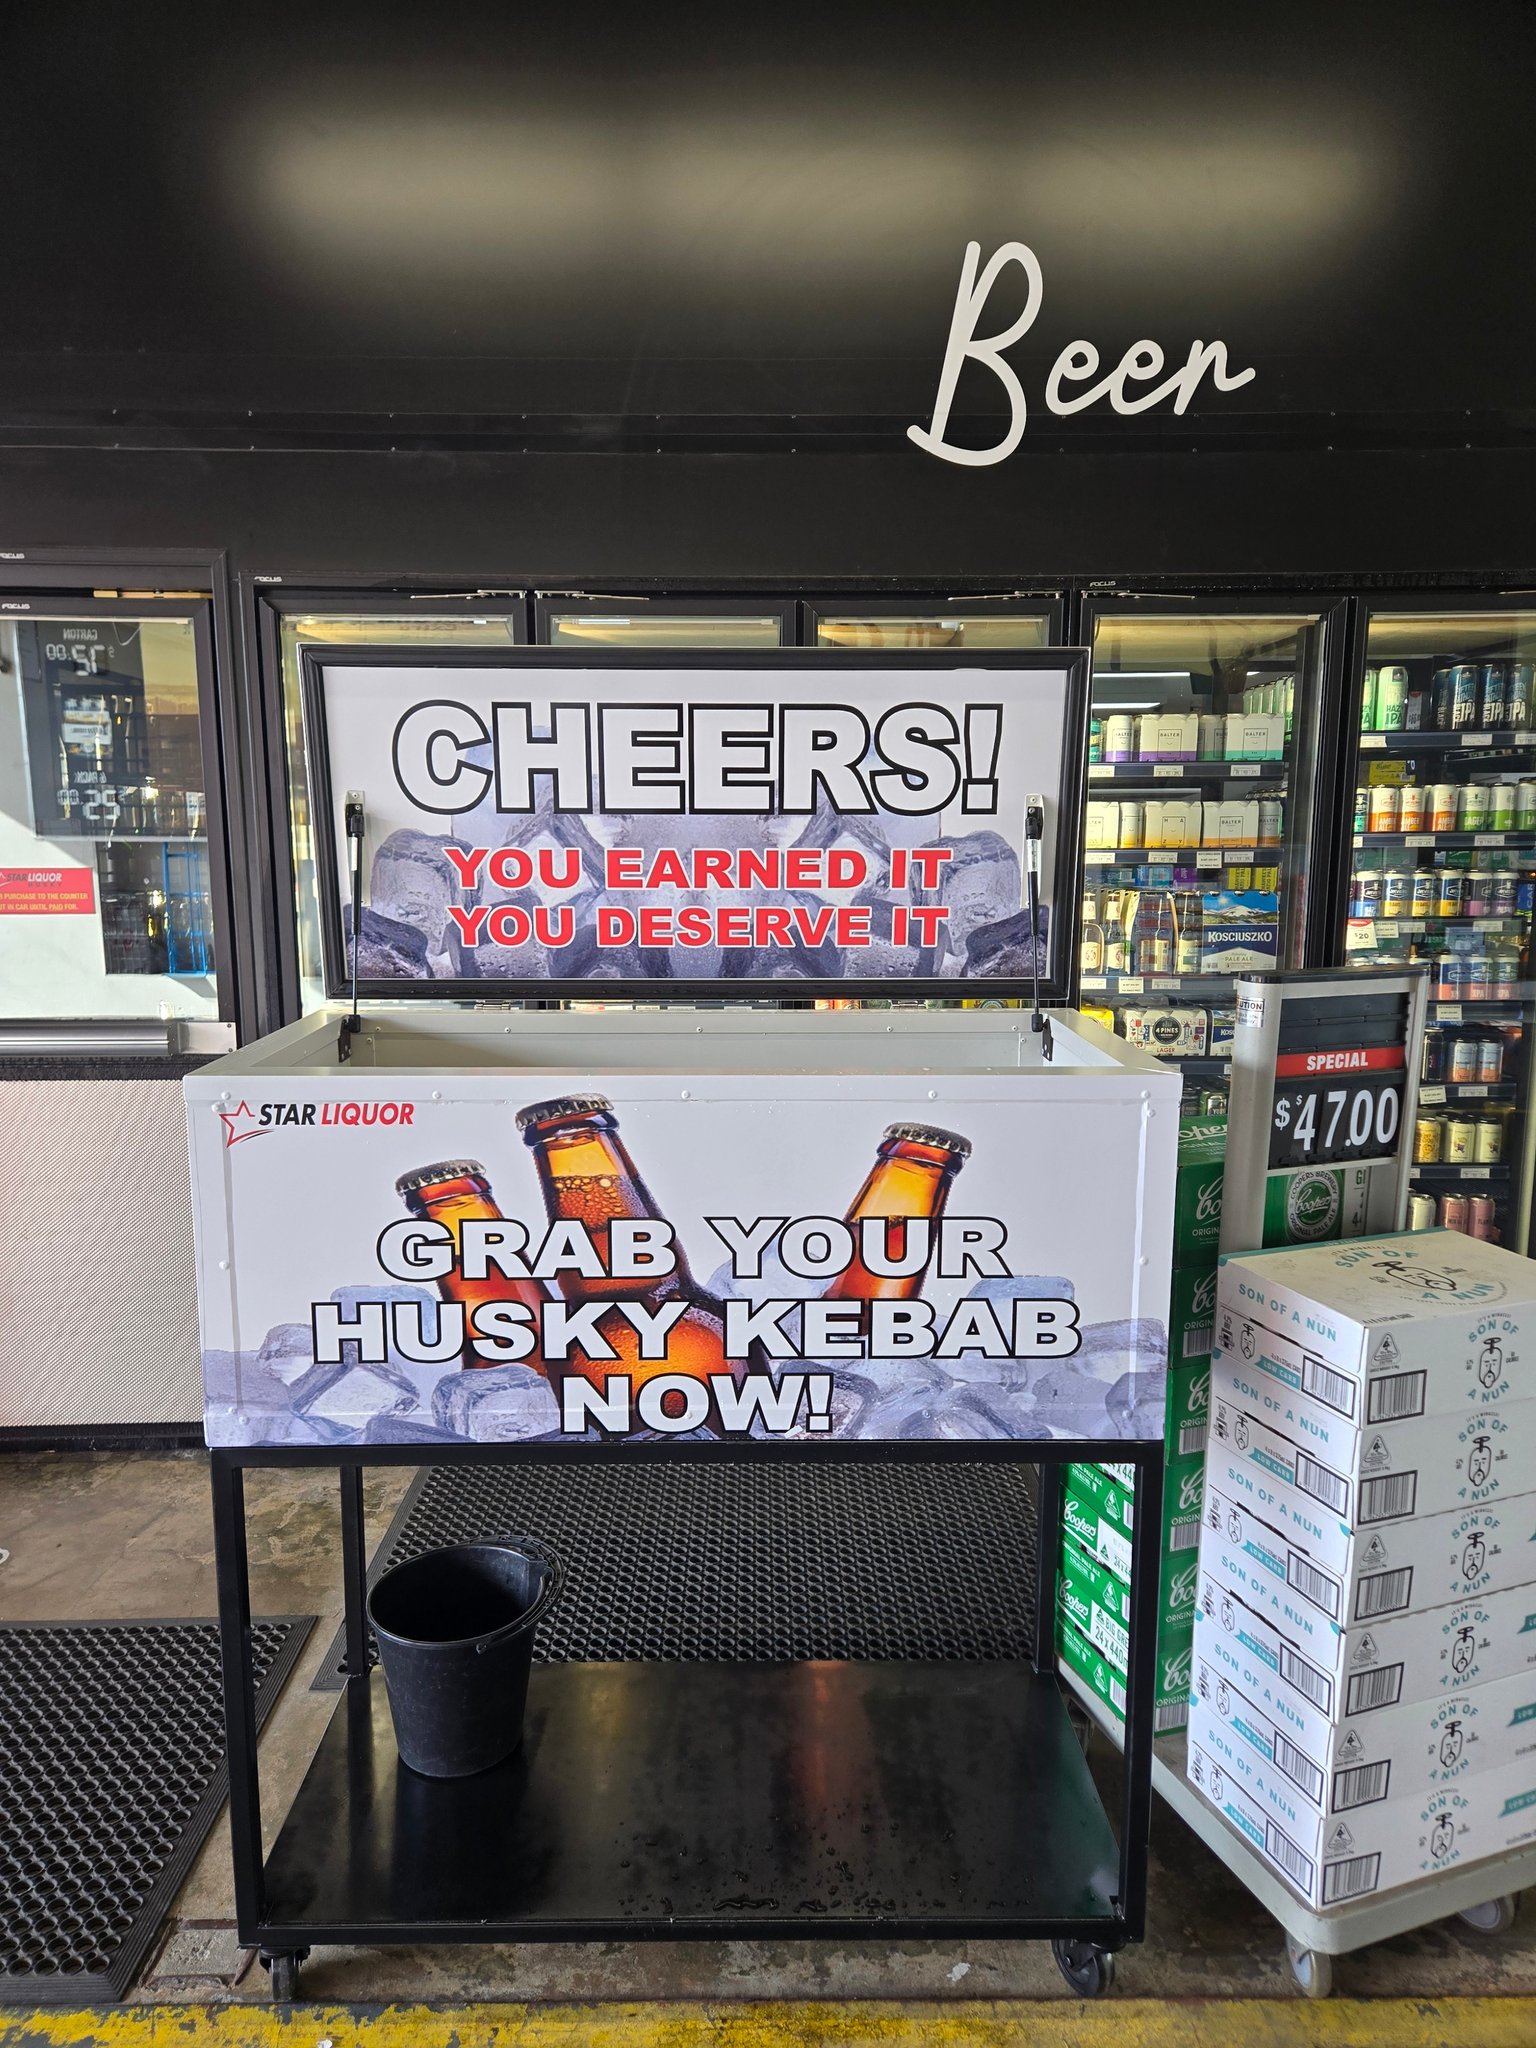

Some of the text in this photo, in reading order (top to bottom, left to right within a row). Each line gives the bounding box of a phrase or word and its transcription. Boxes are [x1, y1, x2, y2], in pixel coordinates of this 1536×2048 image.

[906, 240, 1256, 466] Beer
[1508, 701, 1526, 721] IPA
[392, 699, 1004, 816] CHEERS!
[28, 872, 62, 882] LIQUOR
[443, 847, 953, 891] YOU EARNED IT
[447, 905, 949, 949] YOU DESERVE IT
[1207, 931, 1272, 942] KOSCIUSZKO
[1239, 1002, 1263, 1010] UTION
[1306, 1052, 1368, 1071] SPECIAL
[258, 1102, 415, 1126] STAR LIQUOR
[1290, 1172, 1314, 1200] COOPERS
[1315, 1170, 1338, 1195] BREWERY
[1192, 1227, 1219, 1237] ORIGIN
[1289, 1213, 1311, 1236] ORIGINAL
[1313, 1222, 1328, 1235] PALE
[375, 1216, 1010, 1283] GRAB YOUR
[1335, 1250, 1374, 1268] SON
[1382, 1249, 1418, 1259] OF
[1421, 1282, 1495, 1301] A NUN
[1184, 1318, 1214, 1330] ORIGIN
[1238, 1283, 1265, 1305] SON
[1270, 1299, 1287, 1315] OF
[1291, 1311, 1301, 1323] A
[1306, 1317, 1336, 1342] NUN
[311, 1297, 1082, 1365] HUSKY KEBAB
[1468, 1319, 1520, 1342] SON OF
[1262, 1360, 1278, 1373] LOW
[1467, 1381, 1510, 1403] A NUN
[560, 1373, 832, 1436] NOW!
[1232, 1377, 1259, 1400] SON
[1264, 1396, 1281, 1412] OF
[1285, 1409, 1295, 1422] A
[1299, 1417, 1329, 1443] NUN
[1458, 1419, 1508, 1443] SON OF
[1257, 1453, 1271, 1467] LOW
[1457, 1478, 1500, 1501] A NUN
[1227, 1467, 1253, 1492] SON
[1258, 1488, 1275, 1504] OF
[1279, 1503, 1288, 1516] A
[1293, 1511, 1323, 1540] NUN
[1063, 1498, 1097, 1541] Coopers
[1171, 1512, 1200, 1526] ORIGIN
[1451, 1515, 1500, 1539] SON OF
[1249, 1546, 1265, 1561] LOW
[1450, 1572, 1491, 1594] A NUN
[1059, 1576, 1089, 1620] Coopers
[1221, 1555, 1314, 1635] SON OF A NUN
[1104, 1619, 1116, 1636] BIG
[1441, 1610, 1490, 1635] SON OF
[1214, 1643, 1239, 1672] SON
[1243, 1669, 1260, 1687] OF
[1264, 1688, 1272, 1702] A
[1276, 1700, 1305, 1731] NUN
[1439, 1665, 1480, 1687] A NUN
[1430, 1703, 1479, 1729] SON OF
[1208, 1729, 1296, 1822] SON OF A NUN
[1428, 1758, 1470, 1781] A NUN
